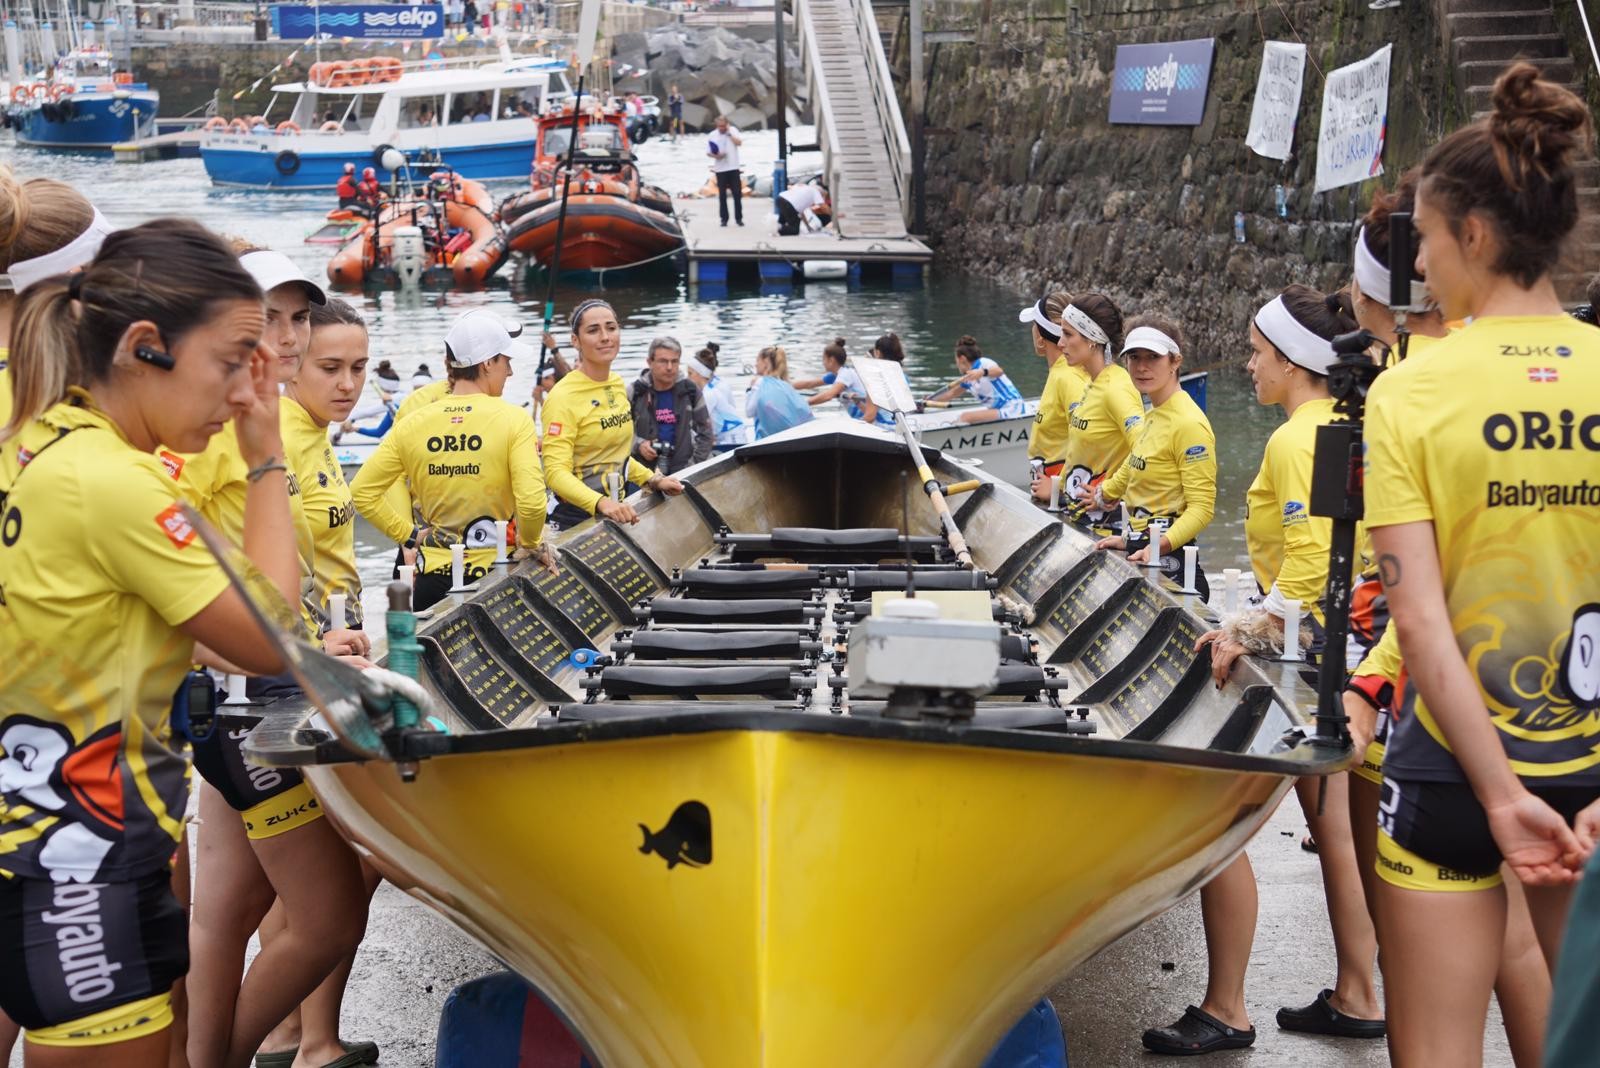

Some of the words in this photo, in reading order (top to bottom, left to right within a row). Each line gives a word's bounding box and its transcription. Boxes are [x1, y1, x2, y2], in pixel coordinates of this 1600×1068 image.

[398, 7, 438, 28] ekp
[940, 428, 1029, 451] AMENA
[428, 463, 480, 477] Babyauto
